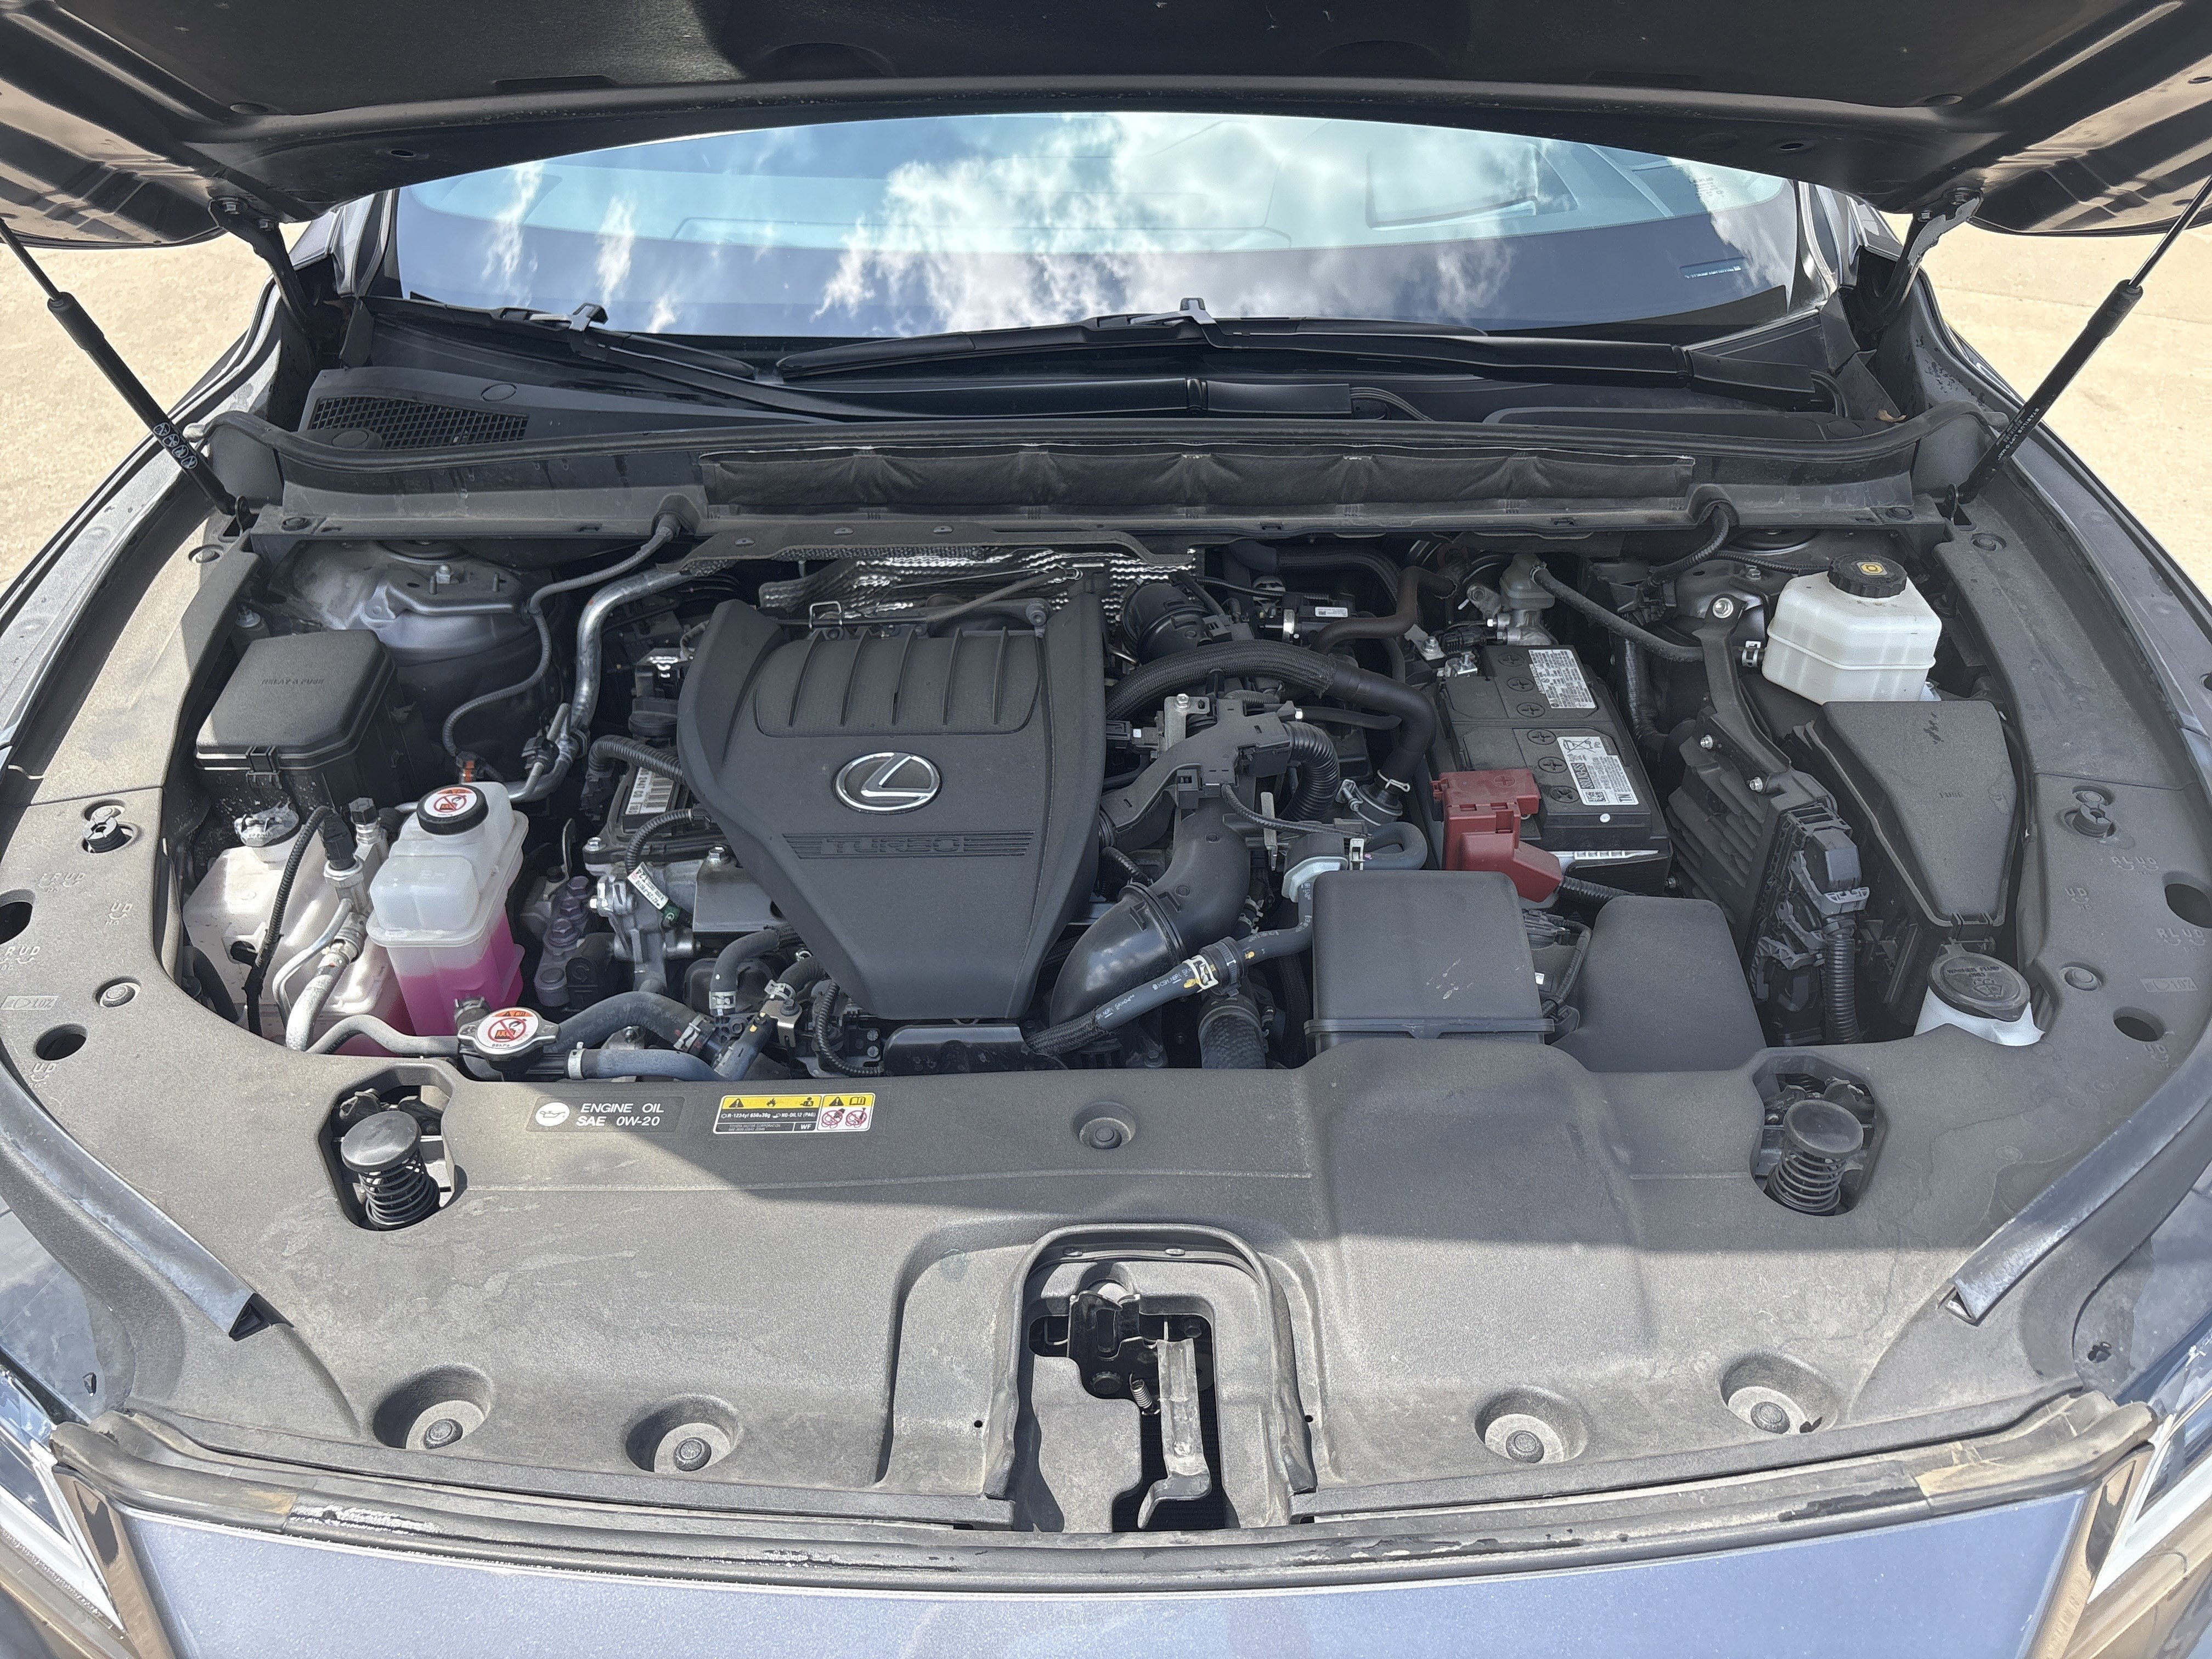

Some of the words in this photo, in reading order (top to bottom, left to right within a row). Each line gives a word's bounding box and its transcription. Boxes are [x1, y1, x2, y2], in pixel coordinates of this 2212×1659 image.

[826, 837, 960, 853] TURBO
[580, 1103, 634, 1113] ENGINE
[642, 1103, 664, 1113] OIL
[576, 1116, 607, 1126] SAE
[616, 1116, 661, 1126] 0W-20
